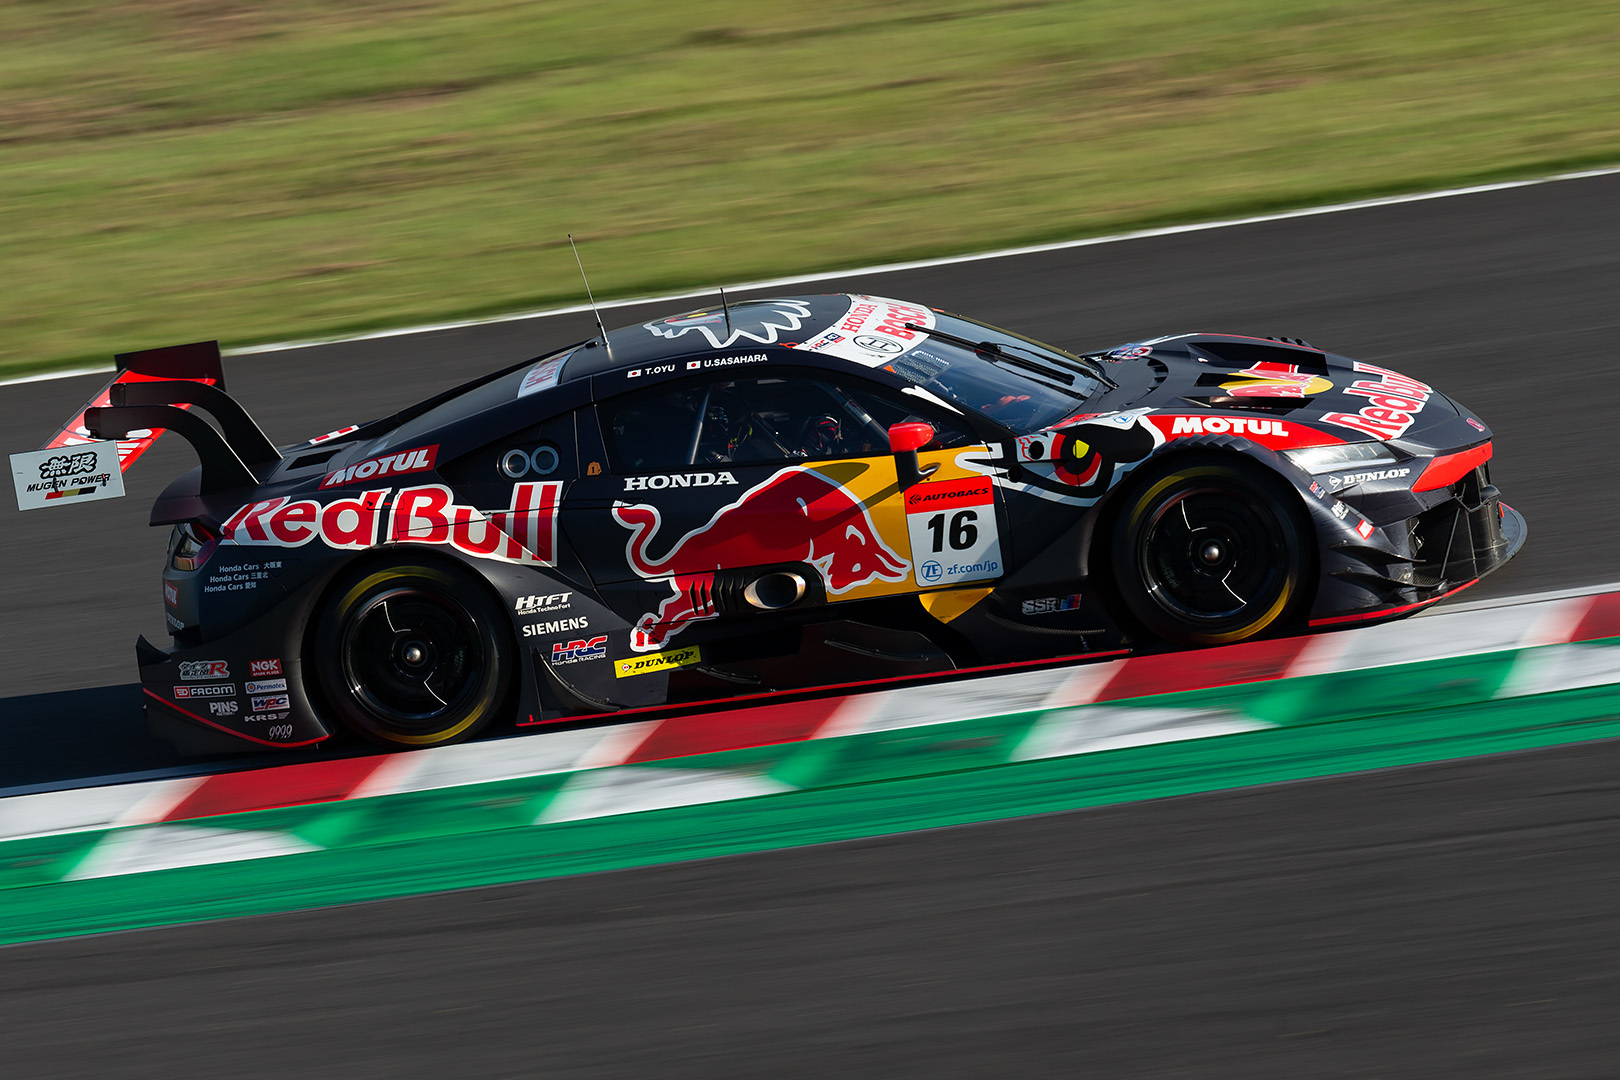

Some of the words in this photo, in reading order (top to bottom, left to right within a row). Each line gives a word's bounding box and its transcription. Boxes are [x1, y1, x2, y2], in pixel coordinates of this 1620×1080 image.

[840, 303, 879, 334] HONDA
[874, 301, 928, 341] BOSCH
[645, 364, 676, 375] T.OYU
[703, 353, 768, 368] U.SASAHARA
[1351, 360, 1434, 403] Bull
[1319, 386, 1427, 443] Red
[1171, 416, 1289, 437] MOTUL
[38, 451, 98, 479] 無限
[325, 448, 430, 485] MOTUL
[26, 477, 68, 493] MUGEN
[70, 473, 111, 487] POWER
[623, 471, 739, 492] HONDA
[1342, 467, 1411, 486] DUNLOP
[923, 487, 989, 502] AUTOBACS
[218, 487, 392, 550] Red
[384, 481, 564, 567] Bull
[927, 510, 978, 552] 16
[219, 564, 242, 573] Honda
[243, 563, 260, 571] Cars
[947, 560, 998, 575] zf.com/jp
[204, 584, 227, 593] Honda
[227, 583, 244, 592] Cars
[209, 574, 233, 583] Honda
[233, 573, 250, 582] Cars
[1022, 598, 1057, 615] SSR
[522, 616, 589, 637] SIEMENS
[551, 635, 608, 662] HRC
[251, 659, 279, 672] NGK
[634, 650, 695, 670] DUNLOP
[190, 686, 234, 696] FACOM
[208, 700, 239, 714] PINS
[244, 712, 278, 722] KRS
